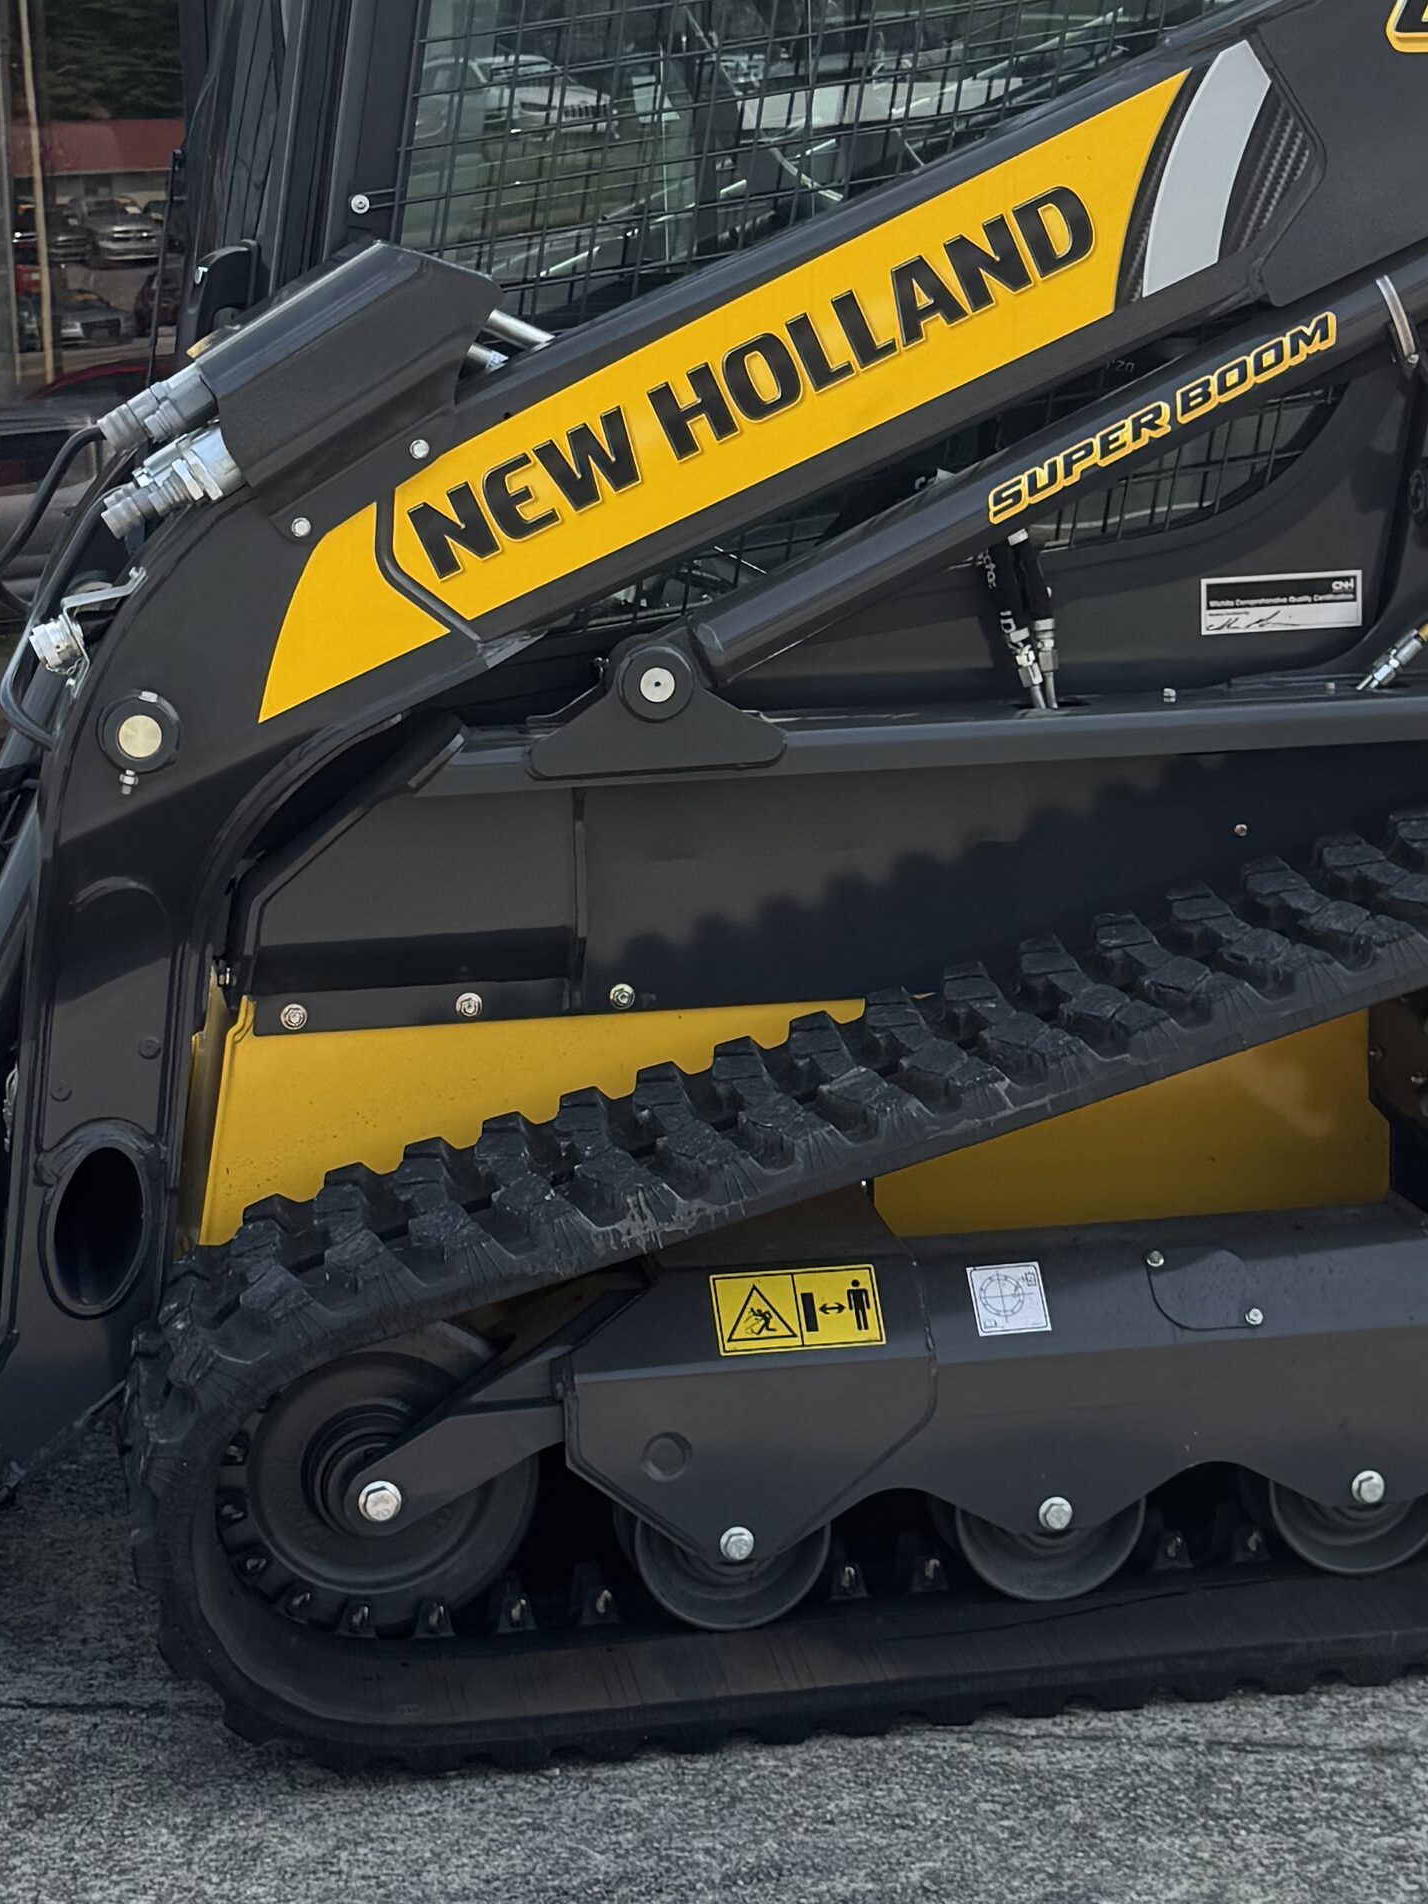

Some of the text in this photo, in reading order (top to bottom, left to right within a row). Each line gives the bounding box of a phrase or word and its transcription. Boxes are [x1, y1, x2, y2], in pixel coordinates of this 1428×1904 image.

[406, 185, 1096, 582] NEW HOLLAND
[988, 311, 1337, 525] SUPER BOOM
[1235, 596, 1288, 607] Comprehensive
[1289, 594, 1312, 604] Quality
